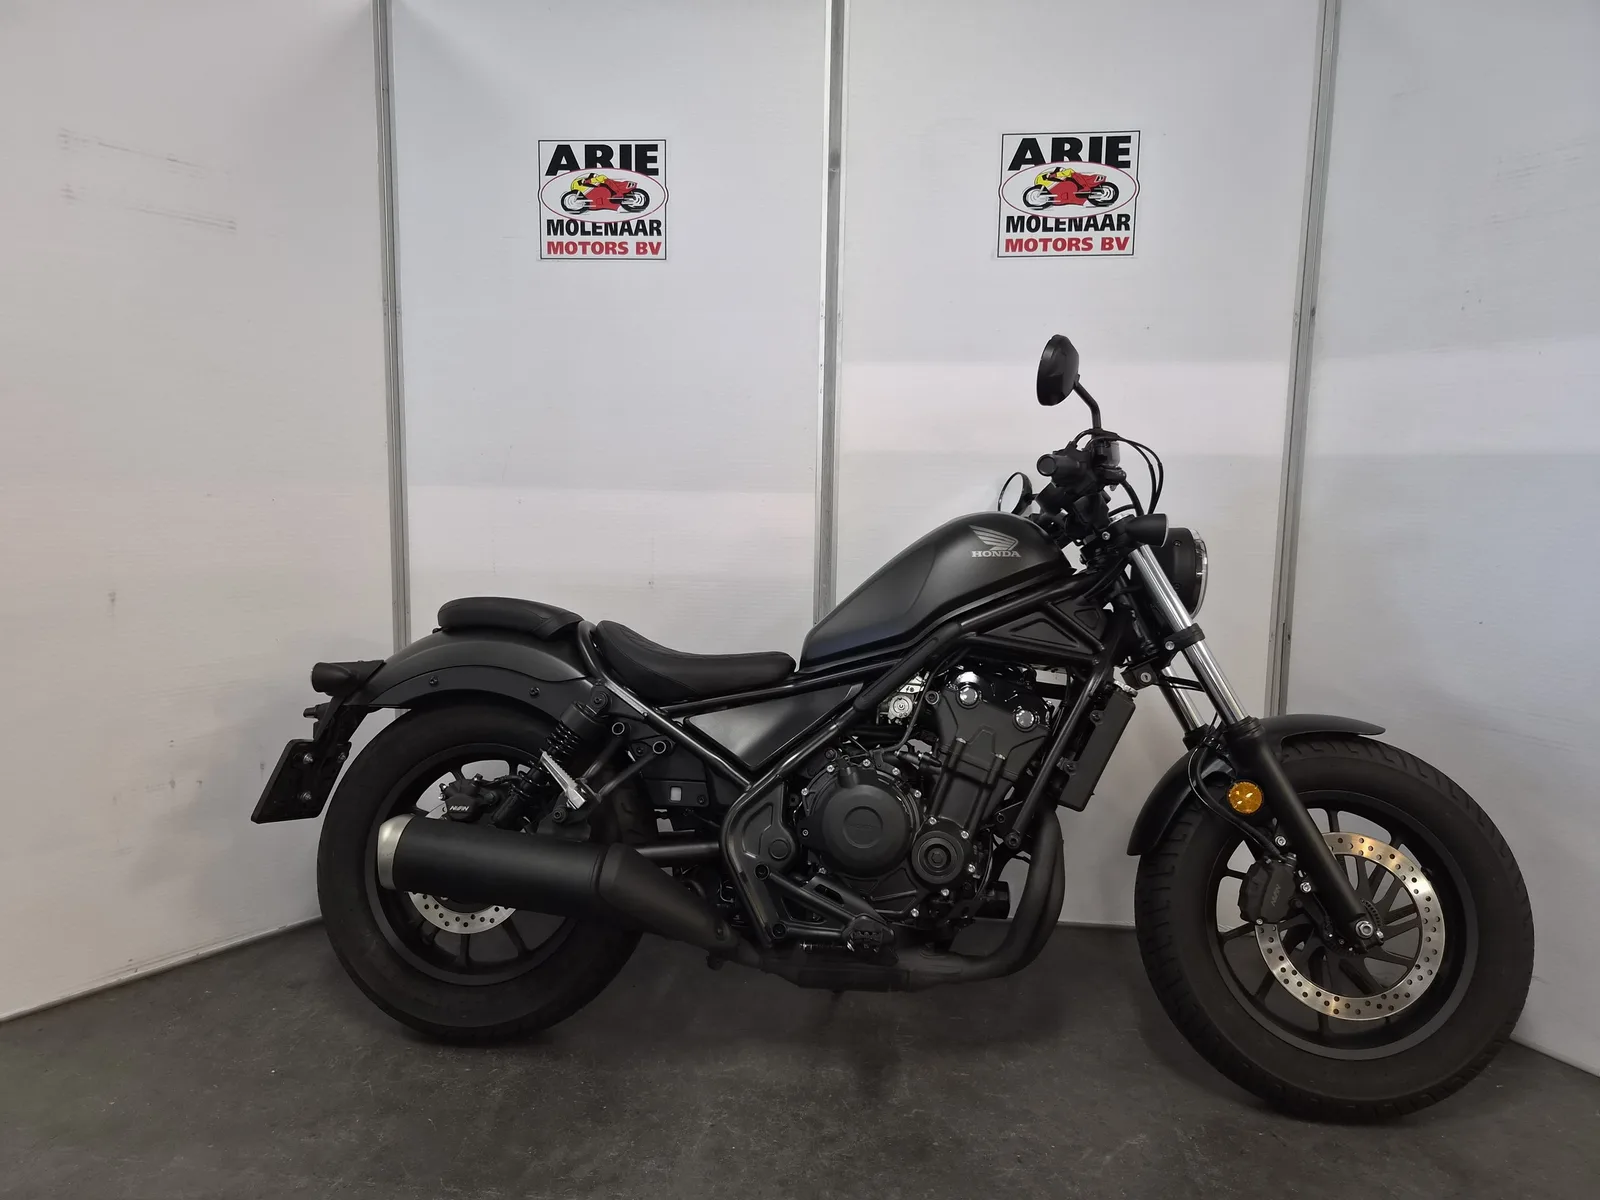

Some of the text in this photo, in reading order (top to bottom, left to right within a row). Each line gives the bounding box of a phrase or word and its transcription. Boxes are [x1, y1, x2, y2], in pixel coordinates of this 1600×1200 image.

[545, 144, 659, 176] ARIE
[1007, 135, 1132, 171] ARIE
[546, 219, 662, 236] MOLENAAR
[1006, 213, 1131, 233] MOLENAAR
[547, 241, 662, 255] MOTORS BV
[1004, 236, 1130, 253] MOTORS BV
[971, 550, 1022, 558] HONDA
